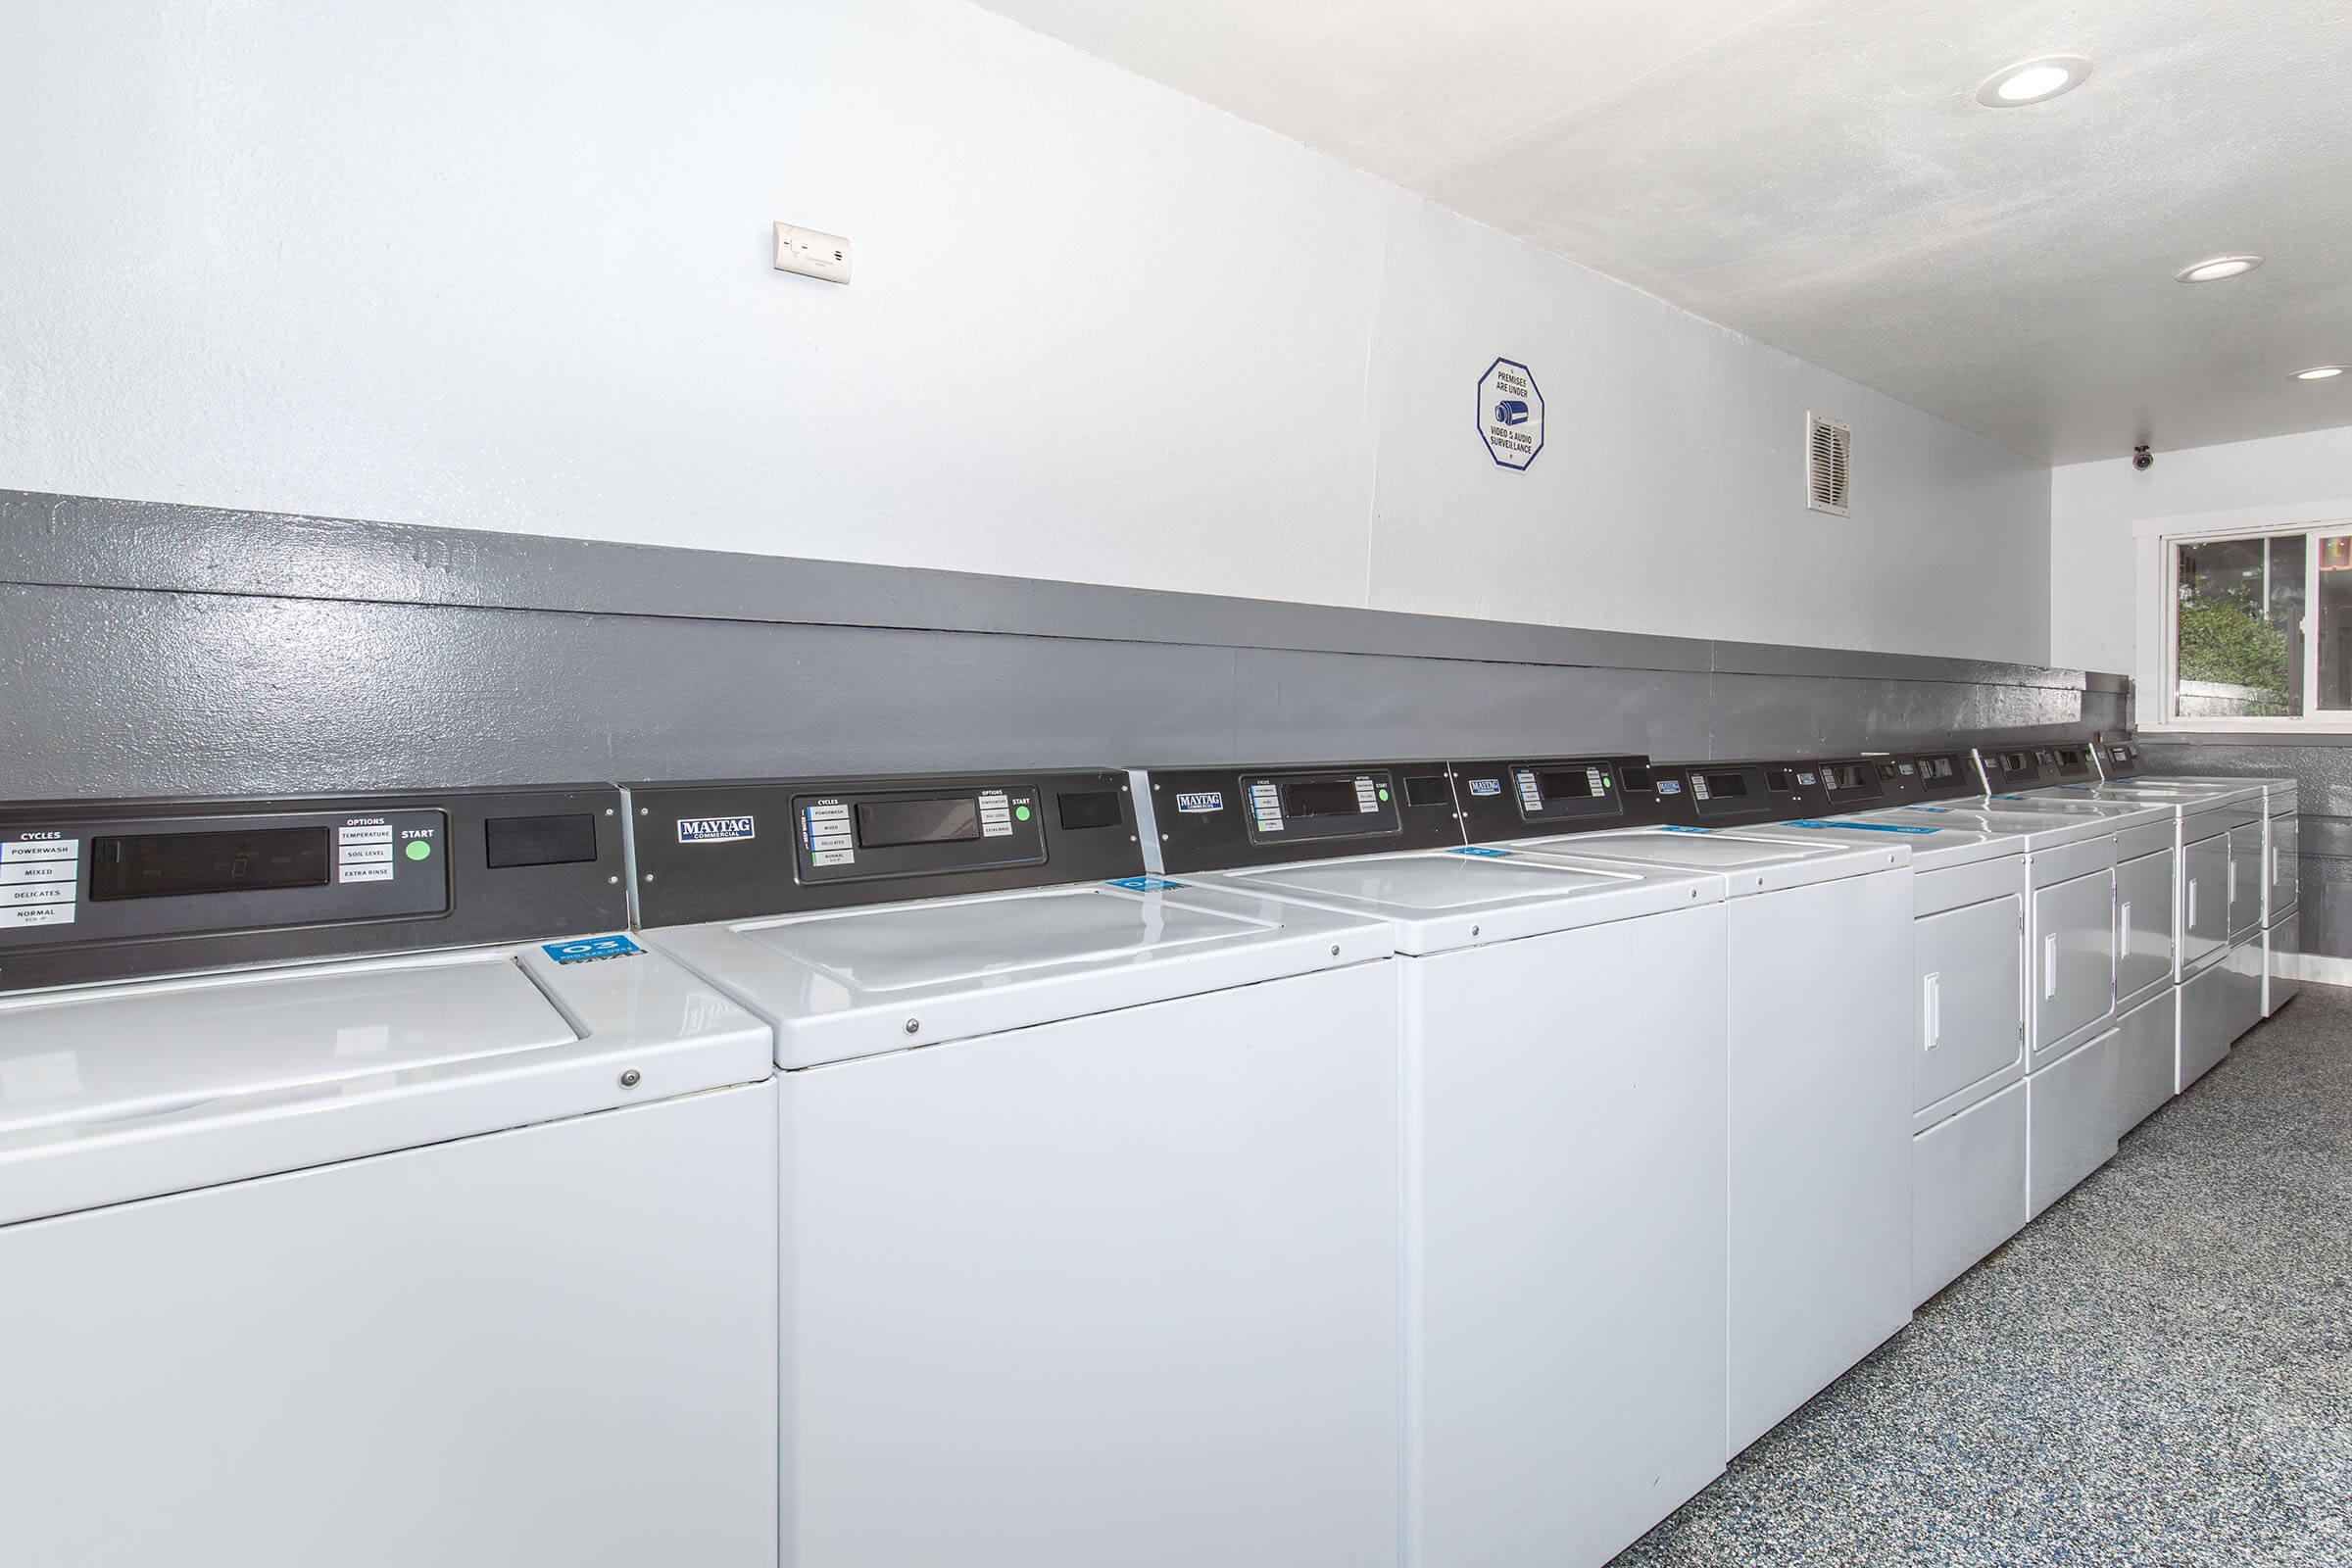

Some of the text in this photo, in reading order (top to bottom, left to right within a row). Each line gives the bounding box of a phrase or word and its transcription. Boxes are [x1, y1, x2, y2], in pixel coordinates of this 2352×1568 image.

[1498, 371, 1527, 387] PREMISES
[1496, 381, 1528, 398] ARE UNDER
[1491, 425, 1507, 438] VIDEO
[1514, 432, 1532, 444] AUDIO
[1491, 436, 1532, 454] SURVEILLANCE
[1180, 795, 1219, 806] MAYTAG
[401, 829, 434, 839] START
[682, 819, 751, 835] MAYTAG
[15, 890, 61, 899] DELICATES
[563, 941, 619, 954] 03
